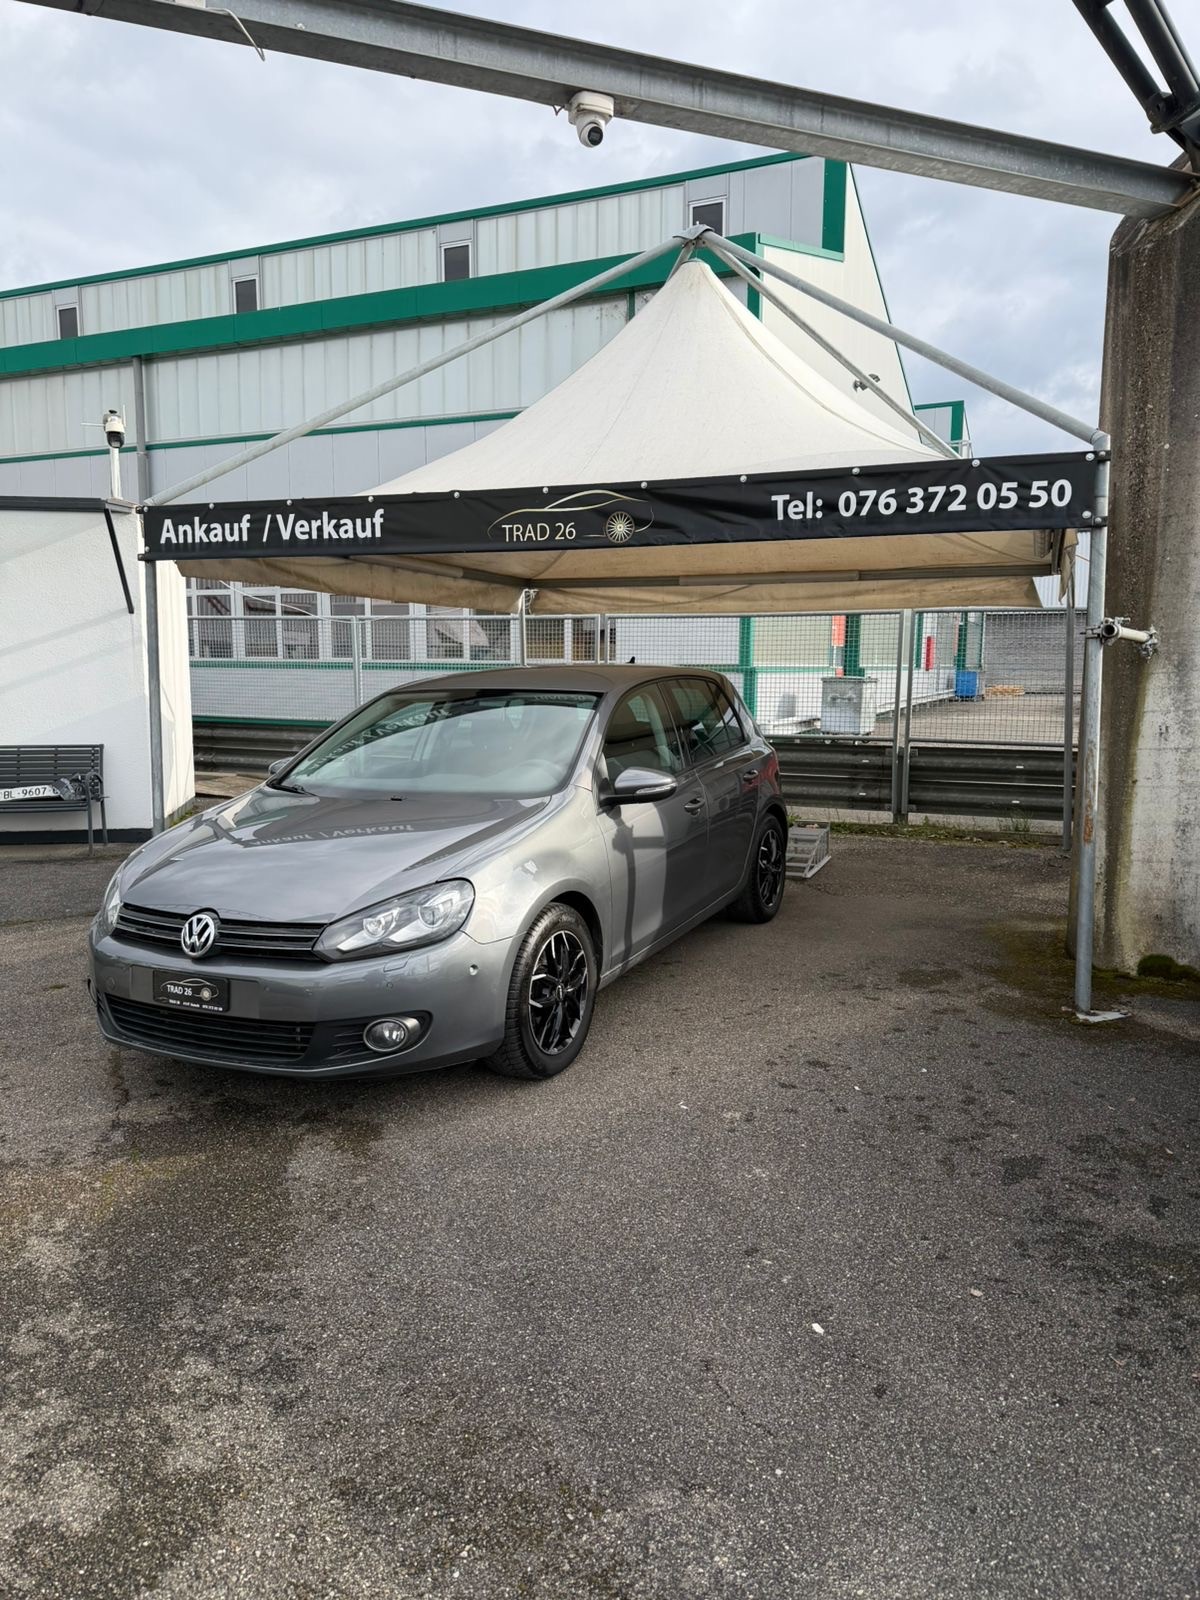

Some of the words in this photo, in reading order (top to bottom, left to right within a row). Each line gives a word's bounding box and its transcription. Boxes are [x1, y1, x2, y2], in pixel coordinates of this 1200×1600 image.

[770, 492, 823, 521] Tel:
[838, 488, 898, 518] 076
[905, 485, 967, 514] 372
[976, 482, 1019, 510] 05
[1028, 479, 1073, 508] 50
[160, 514, 251, 545] Ankauf
[502, 522, 551, 543] TRAD
[554, 521, 577, 540] 26
[22, 787, 47, 797] 9607
[181, 914, 215, 957] VW
[166, 984, 184, 995] TRAD
[184, 987, 193, 996] 26
